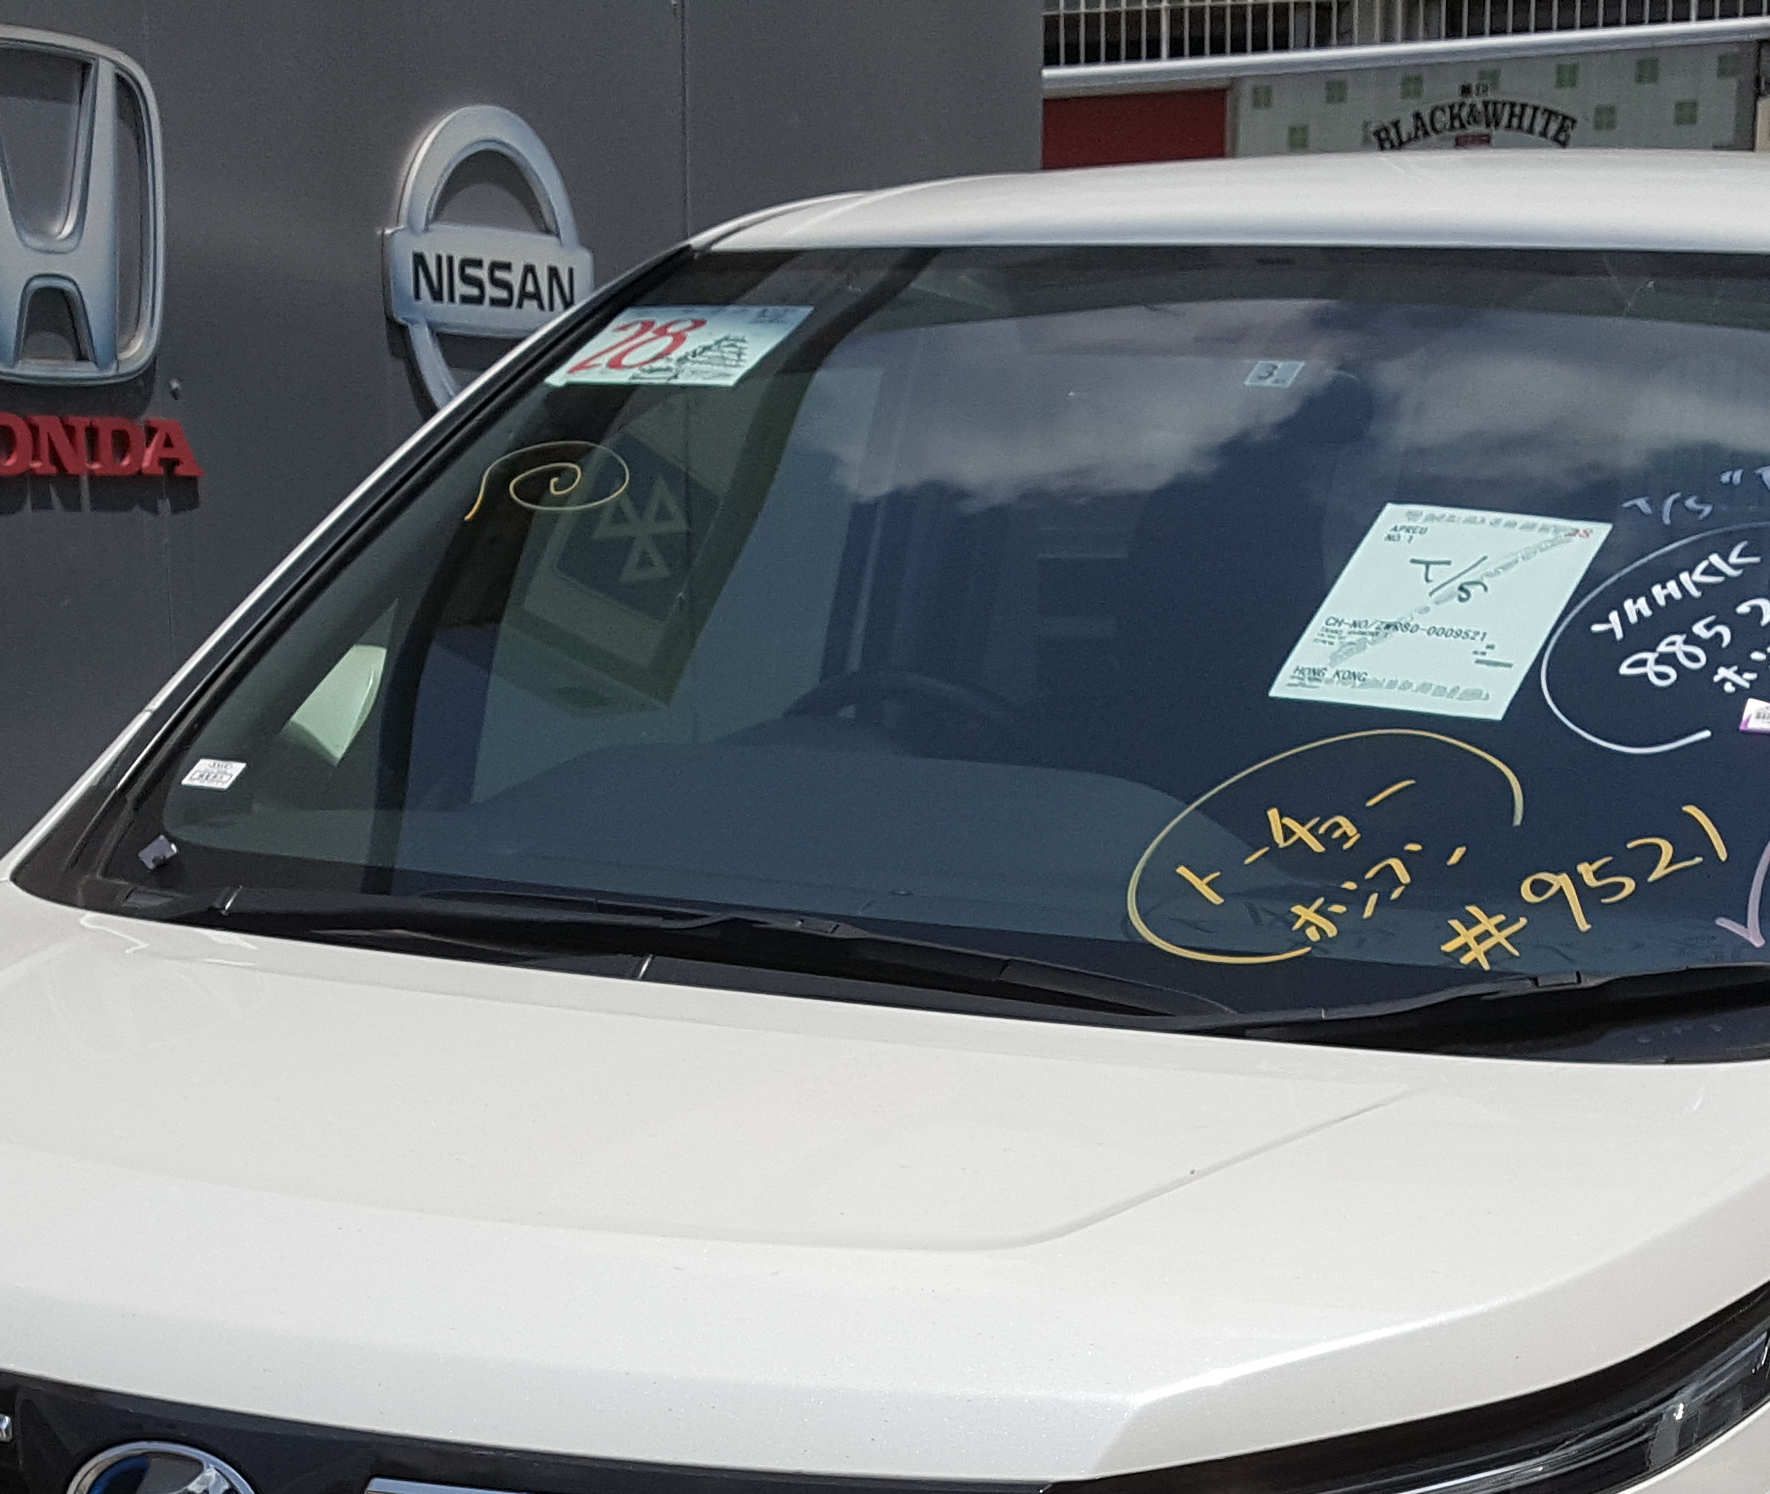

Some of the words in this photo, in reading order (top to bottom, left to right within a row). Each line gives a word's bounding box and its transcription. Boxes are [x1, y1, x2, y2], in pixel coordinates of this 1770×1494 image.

[411, 251, 576, 312] NISSAN
[567, 318, 707, 375] 28
[1292, 665, 1329, 681] HONG
[1333, 669, 1369, 683] KONG
